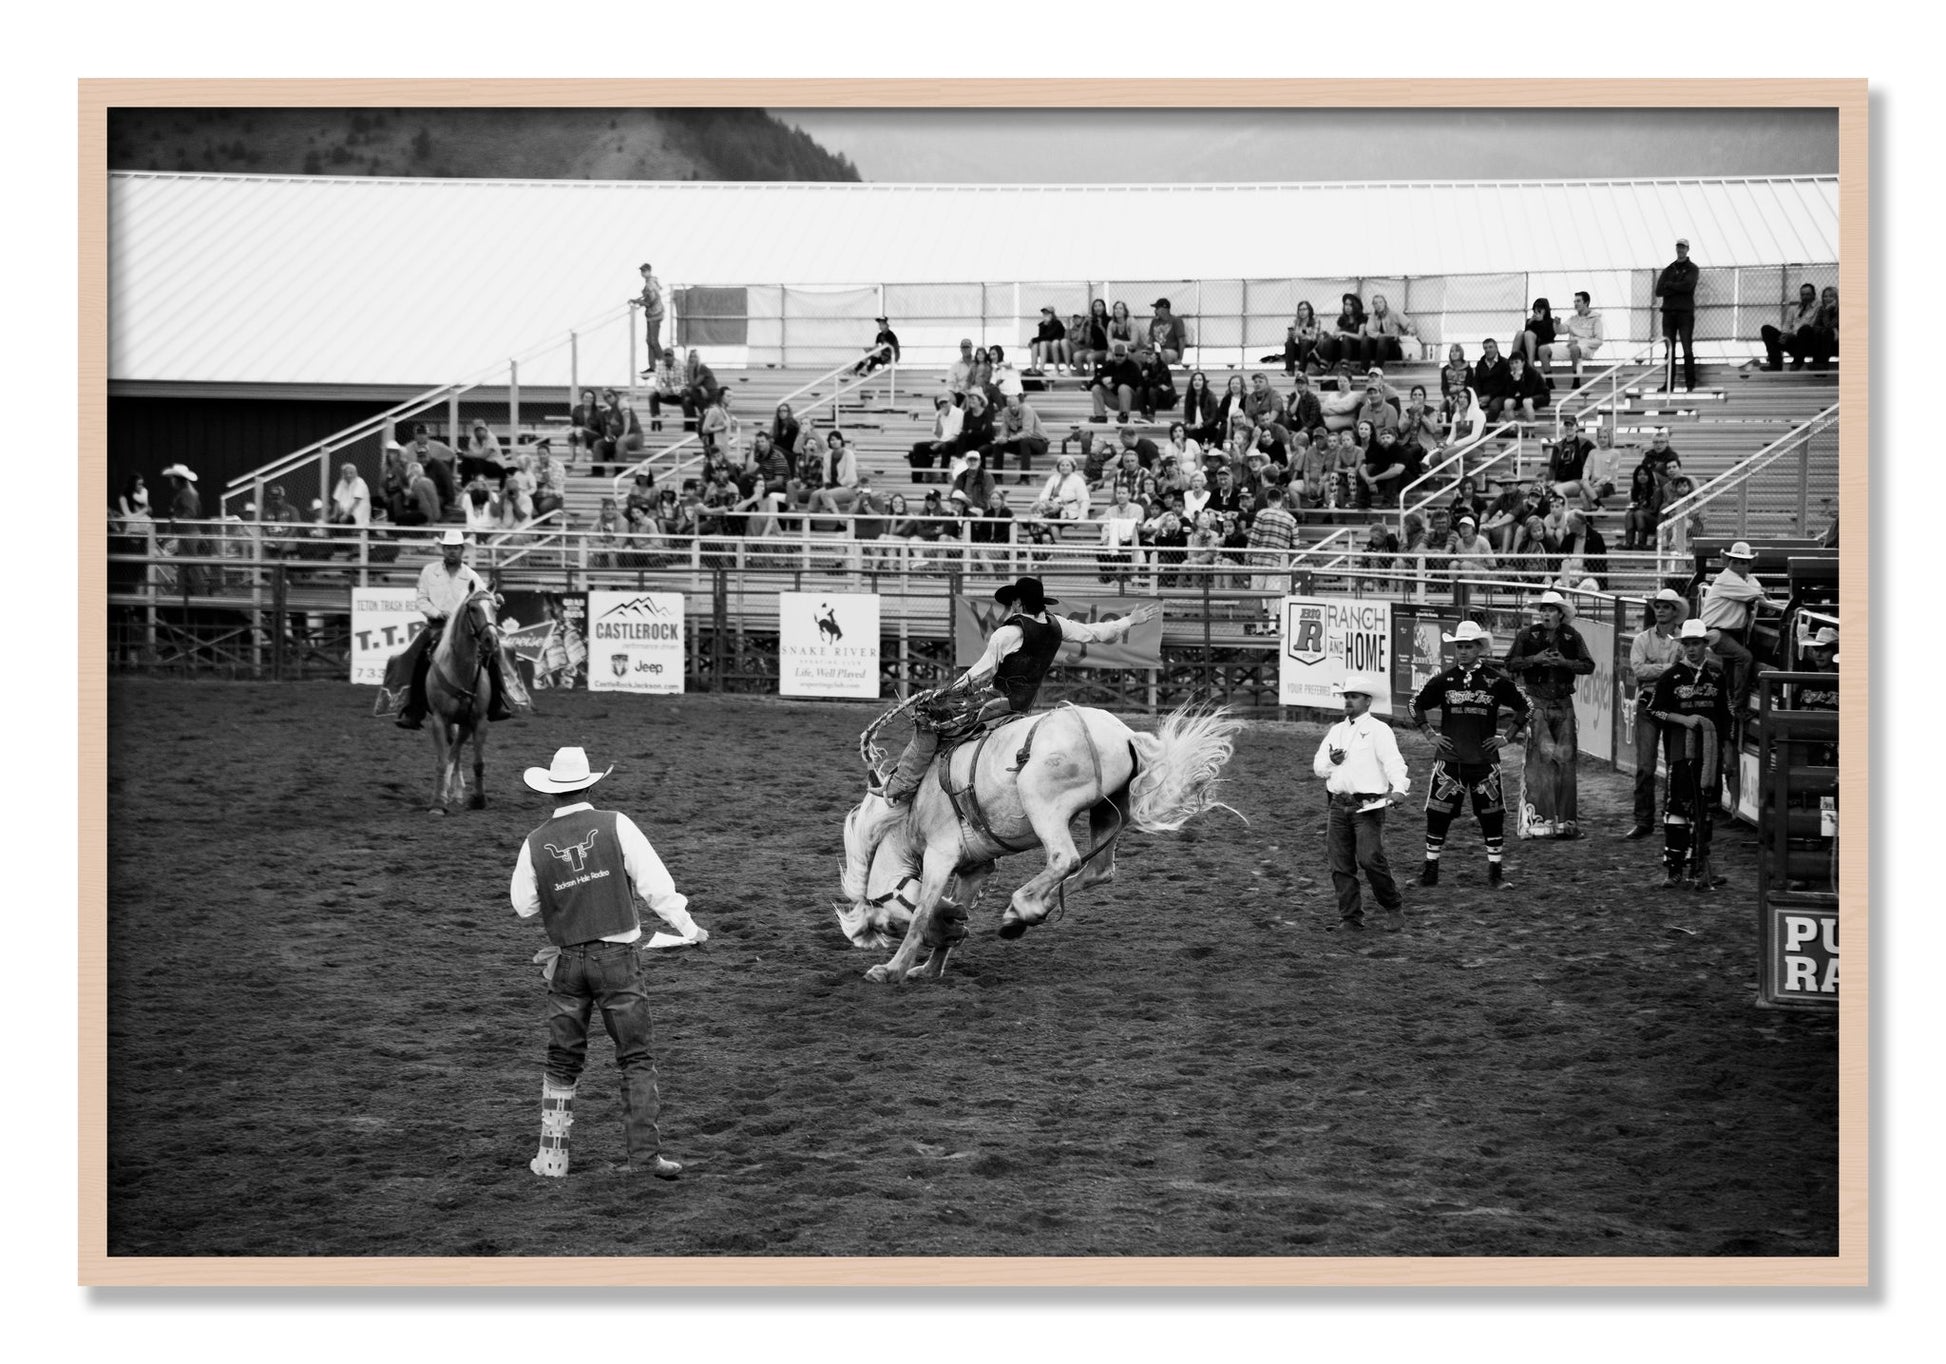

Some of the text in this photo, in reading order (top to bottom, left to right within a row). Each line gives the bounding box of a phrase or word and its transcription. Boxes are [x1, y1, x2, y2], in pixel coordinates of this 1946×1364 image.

[1300, 608, 1321, 620] BIG
[1328, 605, 1386, 631] RANCH
[595, 622, 679, 640] CASTLEROCK
[1293, 620, 1324, 653] R
[781, 646, 877, 657] SNAKE RIVER
[1329, 641, 1344, 654] AND
[1345, 632, 1387, 672] HOME
[635, 660, 664, 675] Jeep
[815, 668, 836, 678] Well
[837, 668, 867, 680] Played
[554, 870, 609, 891] Jackson Hole Rodeo
